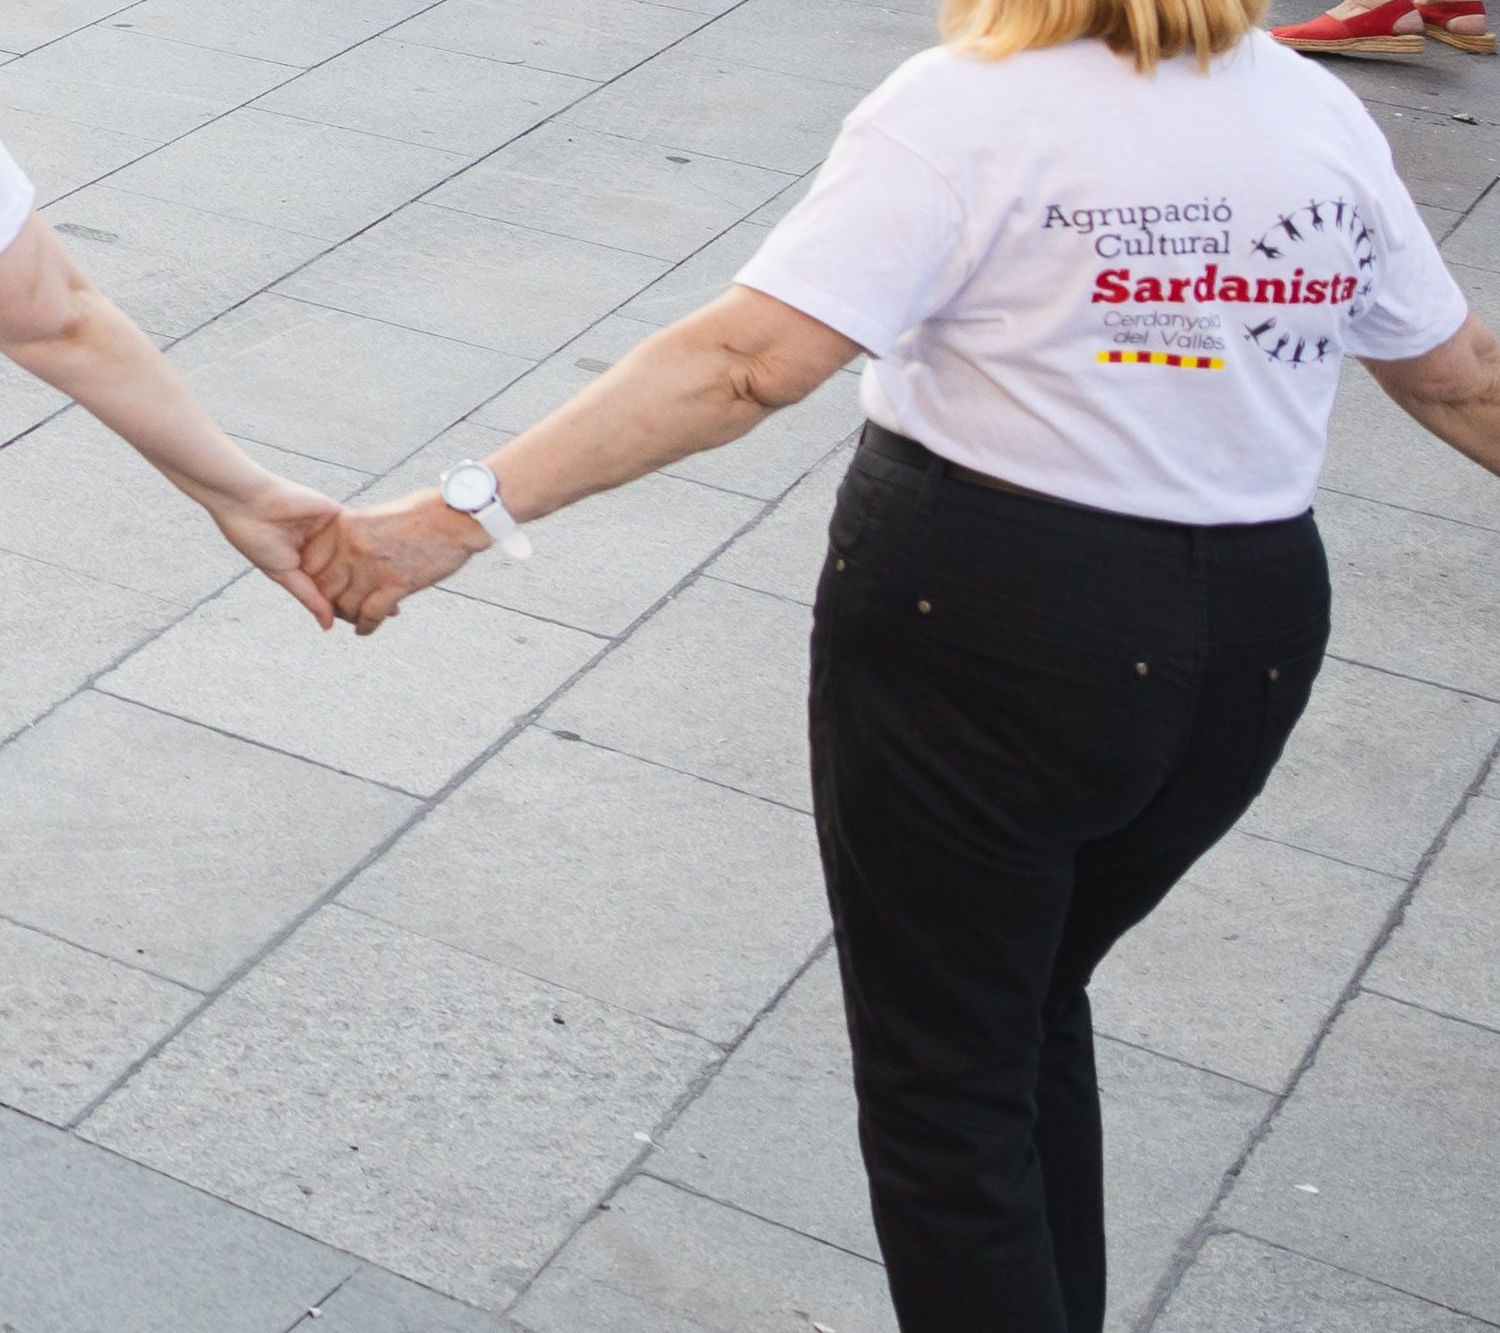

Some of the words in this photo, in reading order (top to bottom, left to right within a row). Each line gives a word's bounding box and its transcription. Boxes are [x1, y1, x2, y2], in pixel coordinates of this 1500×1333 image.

[1043, 197, 1232, 235] Agrupació
[1095, 231, 1230, 259] Cultural
[1091, 264, 1358, 305] Sardanista
[1103, 310, 1222, 335] Cerdanyola
[1113, 328, 1149, 346] del
[1161, 329, 1225, 351] Vallès
